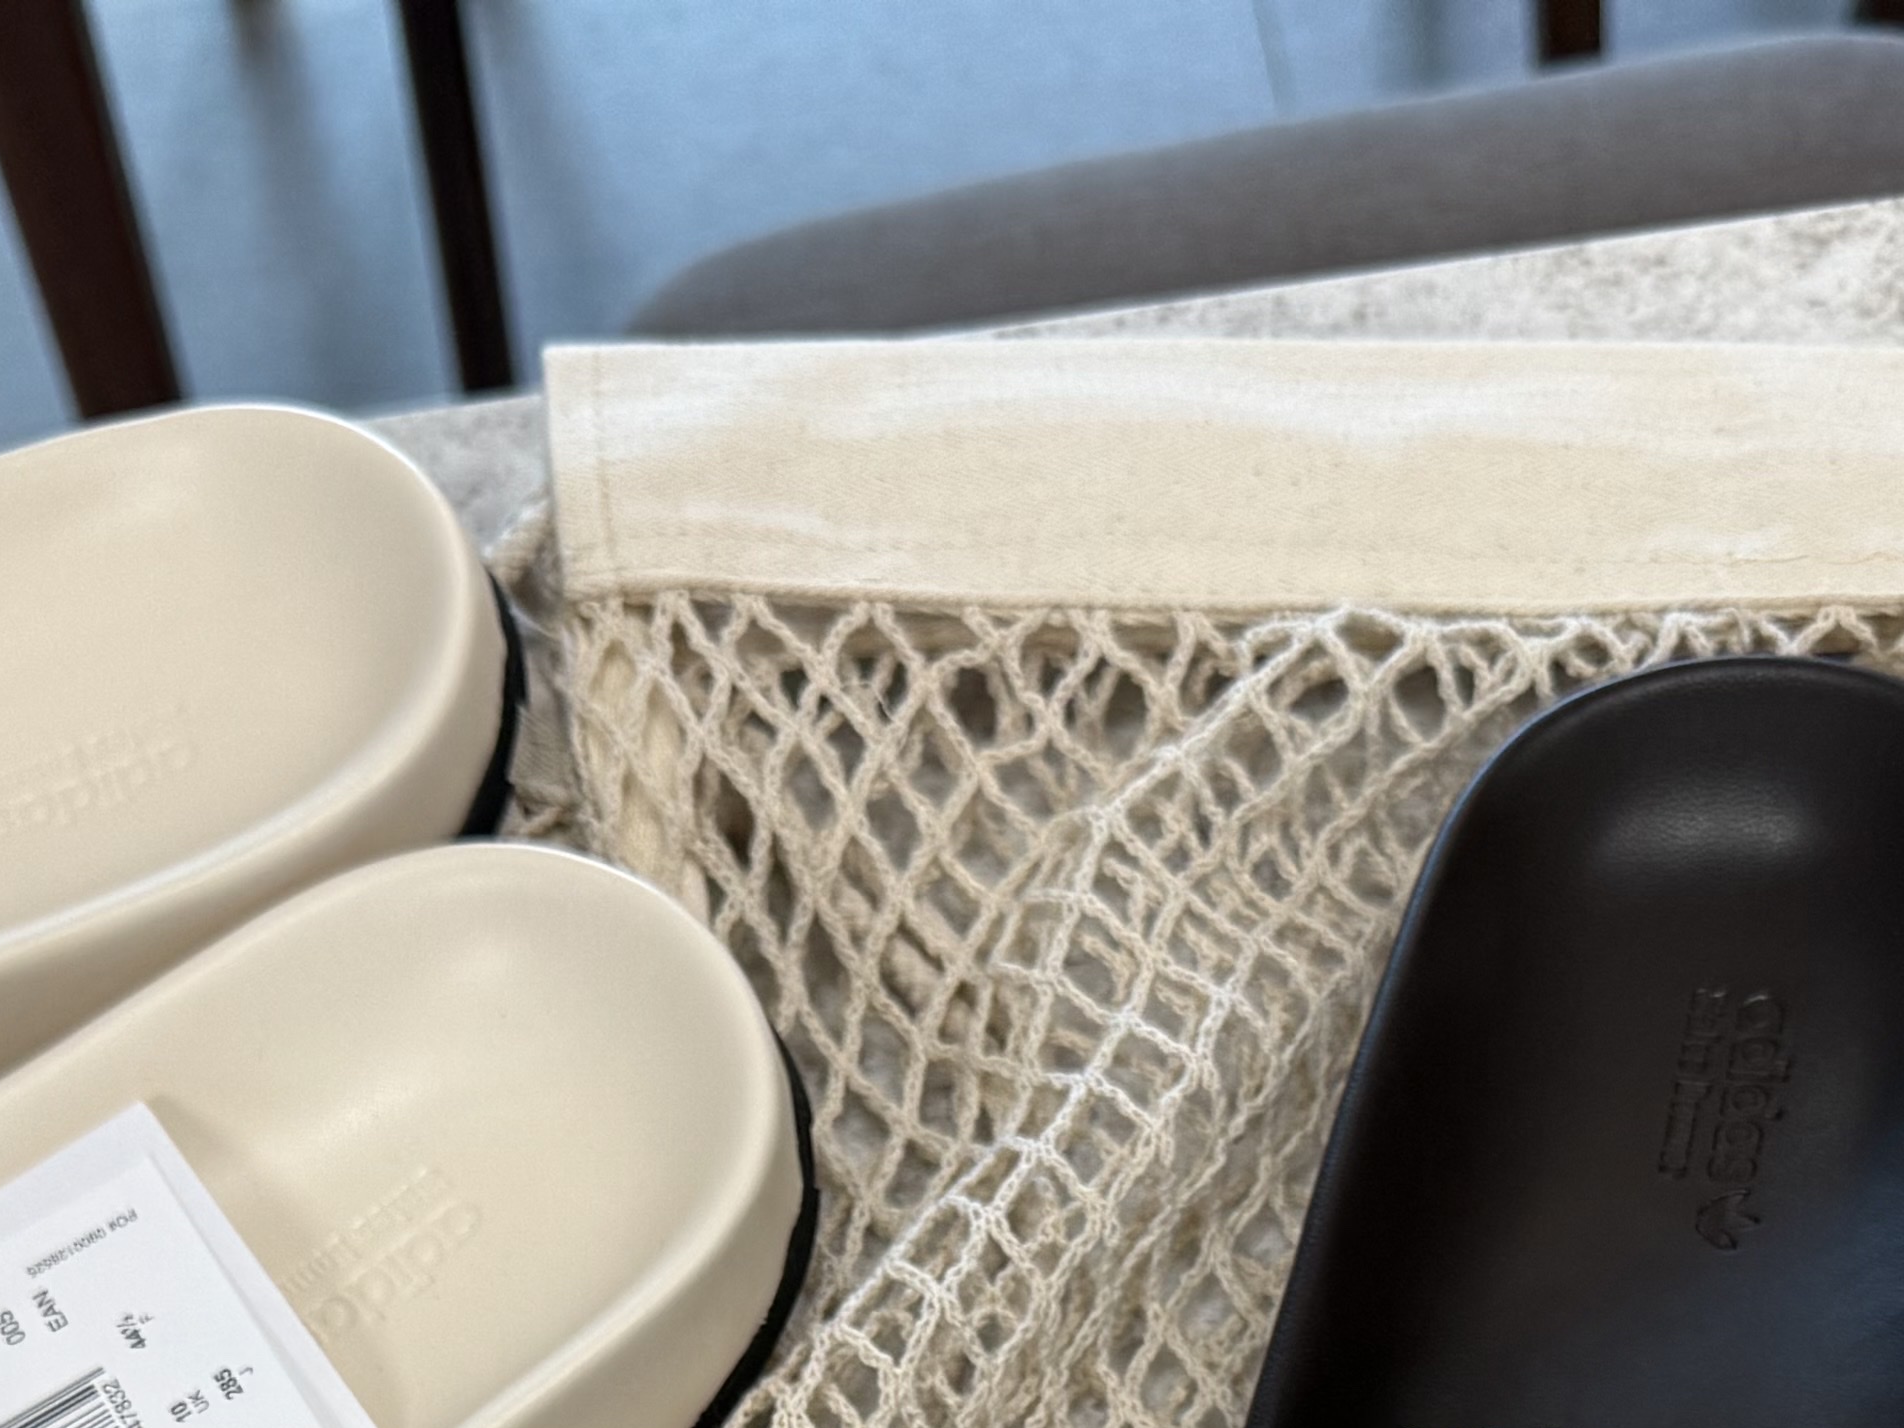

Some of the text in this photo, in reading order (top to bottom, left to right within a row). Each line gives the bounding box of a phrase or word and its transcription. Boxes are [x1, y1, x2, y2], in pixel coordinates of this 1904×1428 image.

[32, 1288, 69, 1333] EAN
[212, 1367, 245, 1401] 285
[169, 1400, 192, 1424] 10
[187, 1388, 211, 1414] UK
